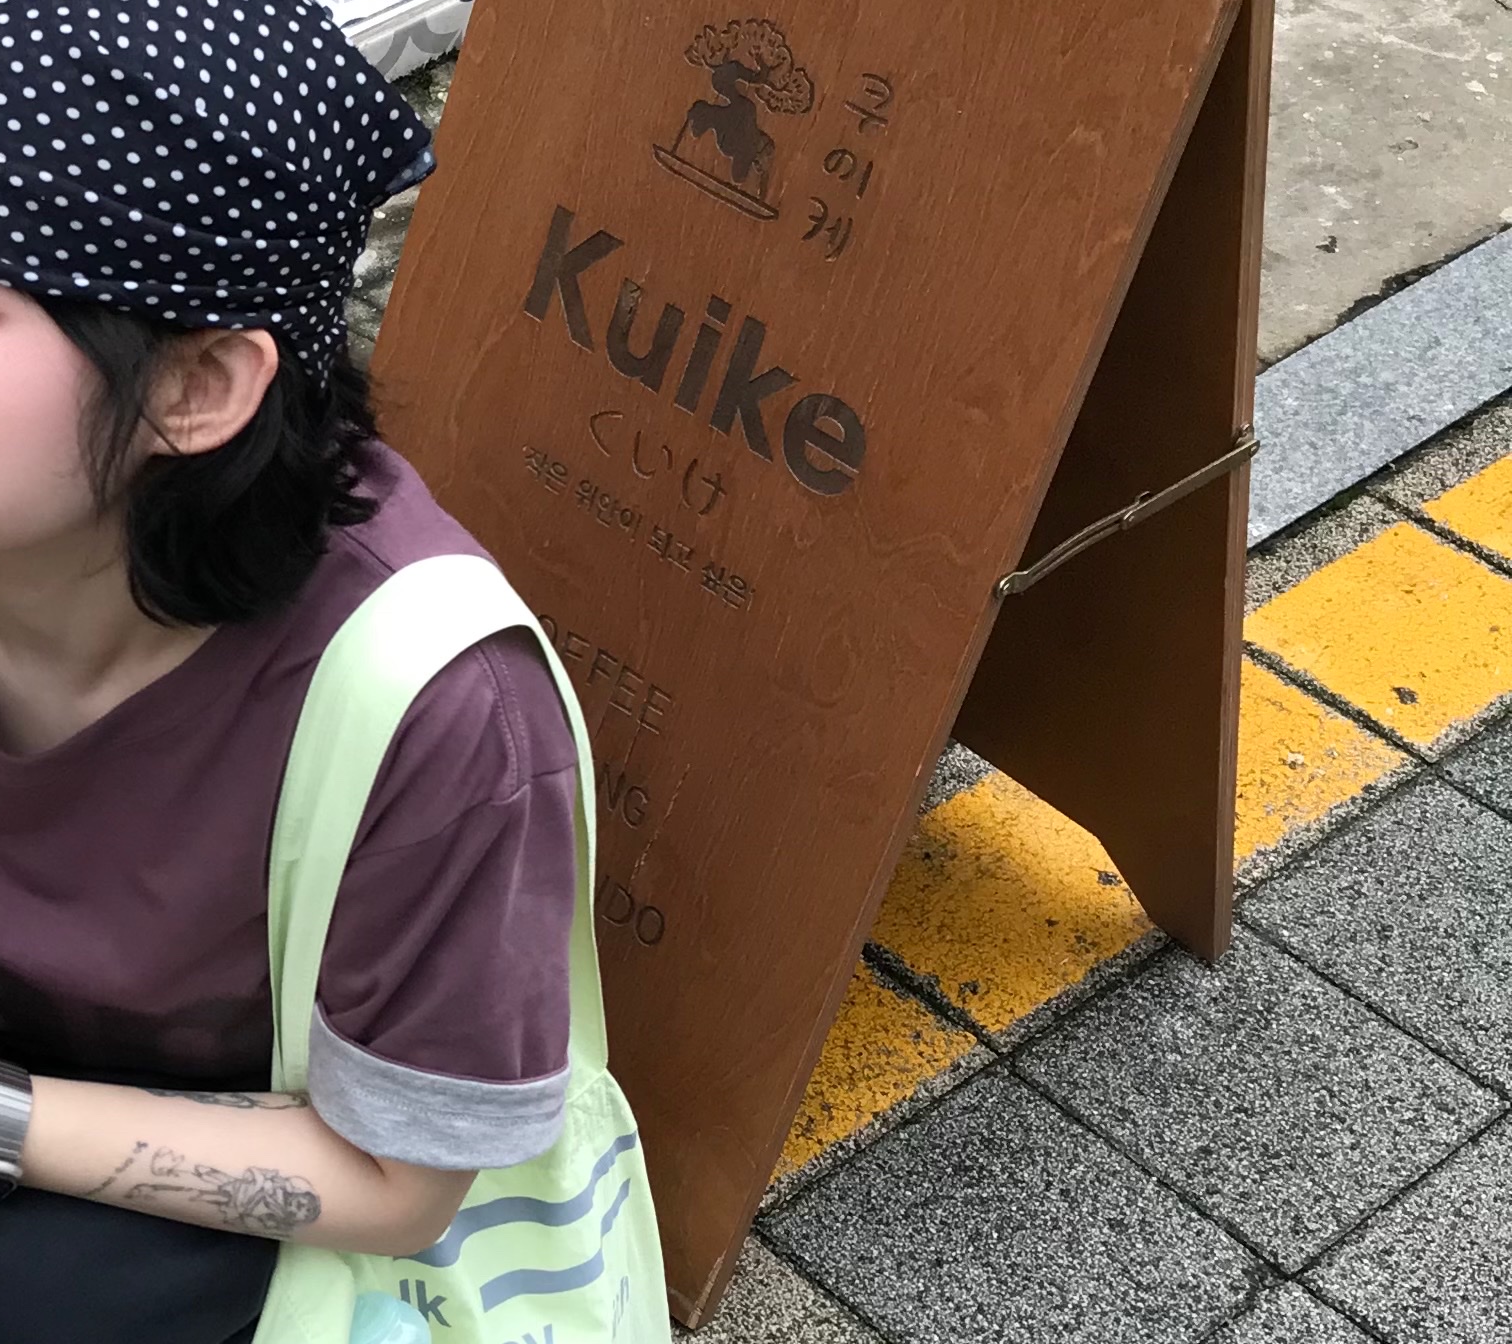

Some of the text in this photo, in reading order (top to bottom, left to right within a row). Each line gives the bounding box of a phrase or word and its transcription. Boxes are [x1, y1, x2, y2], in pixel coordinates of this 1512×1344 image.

[523, 205, 867, 497] Kuike
[590, 410, 727, 517] くいけ
[538, 613, 673, 735] OFFEE
